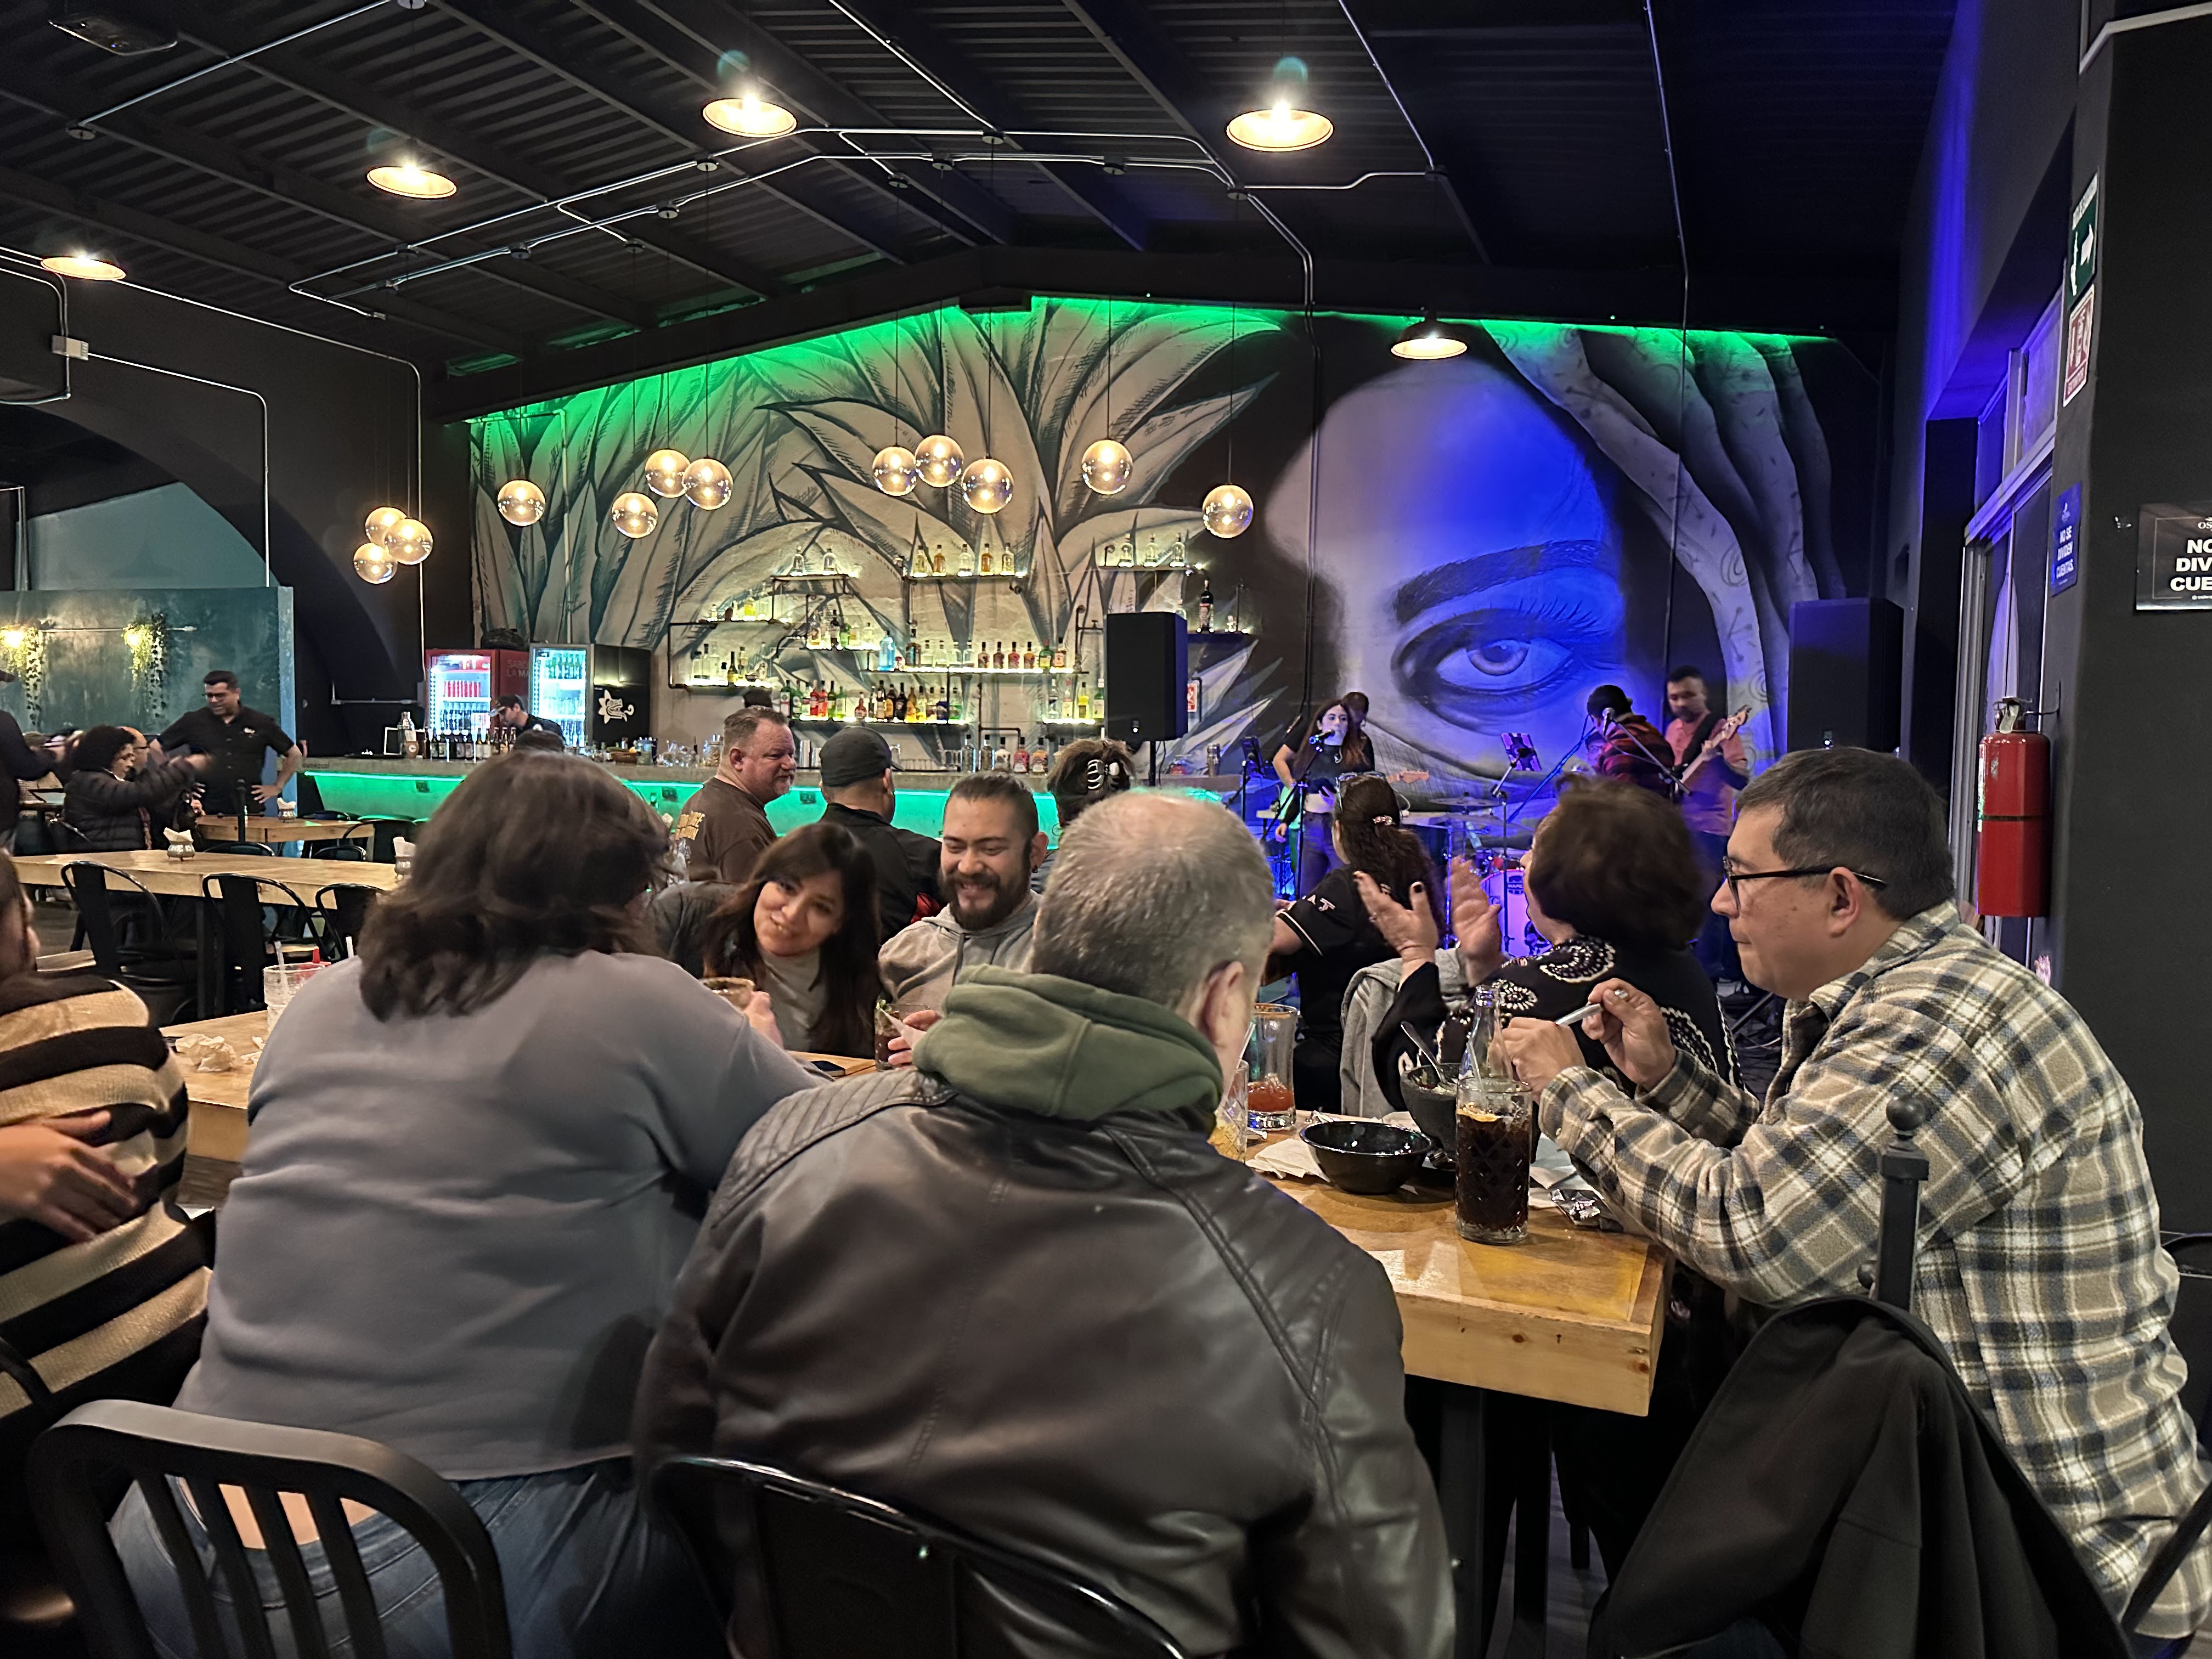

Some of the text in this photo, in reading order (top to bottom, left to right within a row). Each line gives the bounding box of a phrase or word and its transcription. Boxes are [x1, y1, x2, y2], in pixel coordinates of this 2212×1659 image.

[2187, 539, 2212, 554] NO
[2176, 557, 2212, 572] DIV
[2170, 577, 2212, 591] CUE
